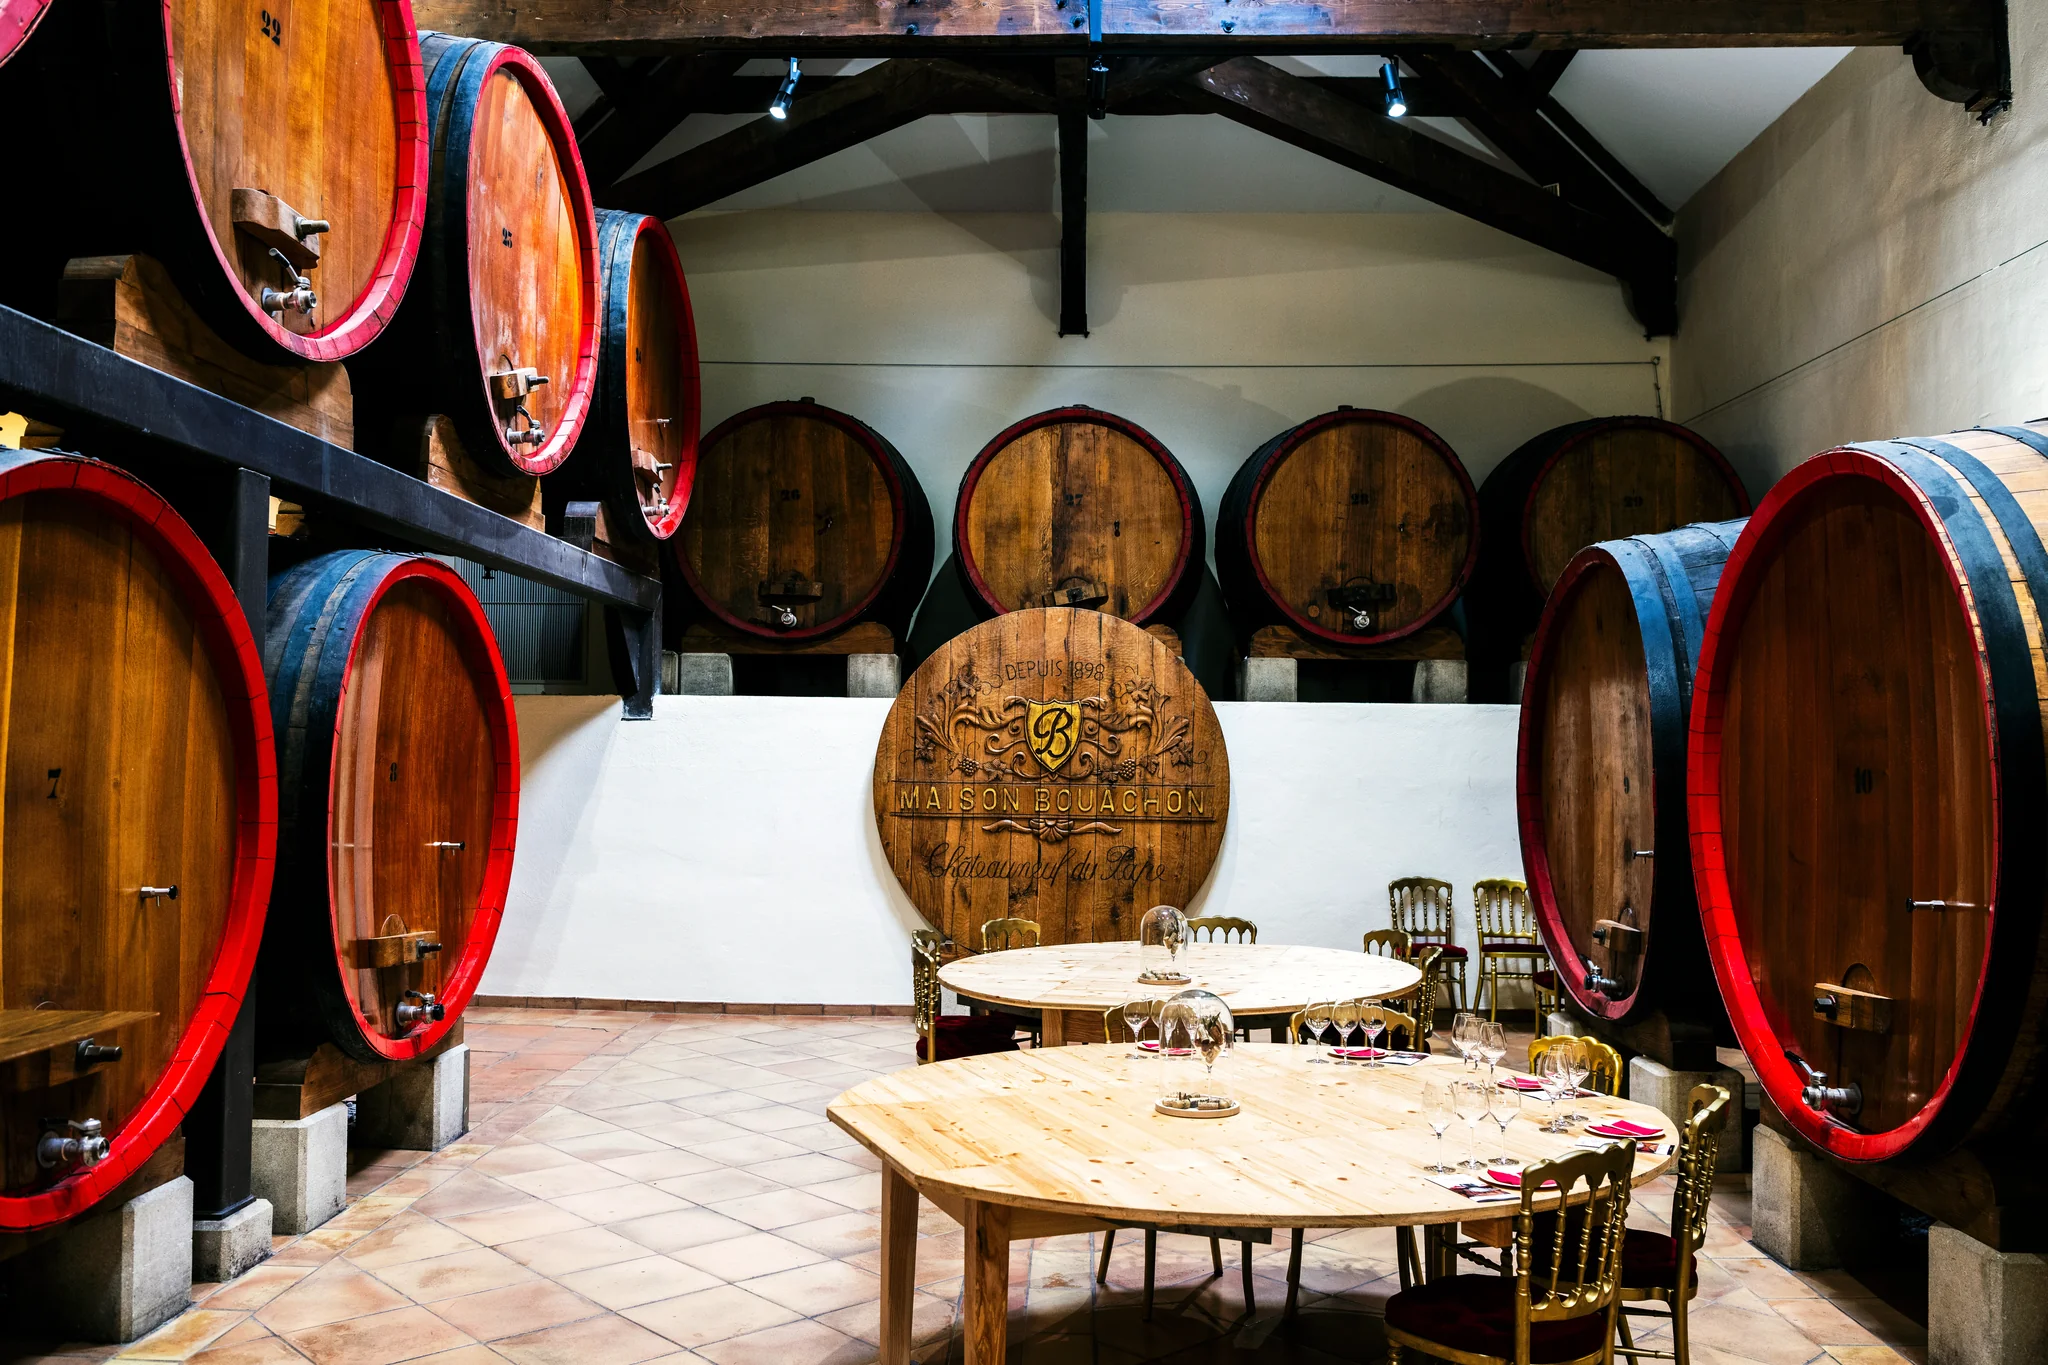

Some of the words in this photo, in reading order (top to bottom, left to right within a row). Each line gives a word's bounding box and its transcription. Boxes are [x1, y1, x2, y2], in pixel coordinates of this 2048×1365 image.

[261, 9, 281, 47] 22
[780, 489, 801, 501] 26
[1065, 493, 1083, 506] 27
[1005, 660, 1063, 680] DEPUIS
[1069, 660, 1105, 681] 1898
[1033, 707, 1074, 758] B
[47, 768, 61, 799] 7
[389, 762, 397, 782] 8
[1624, 776, 1630, 794] 9
[1855, 767, 1873, 794] 10
[900, 785, 1020, 812] MAISON
[1034, 787, 1205, 815] BOUACHON
[1070, 849, 1098, 882] du
[1101, 845, 1167, 888] Pape
